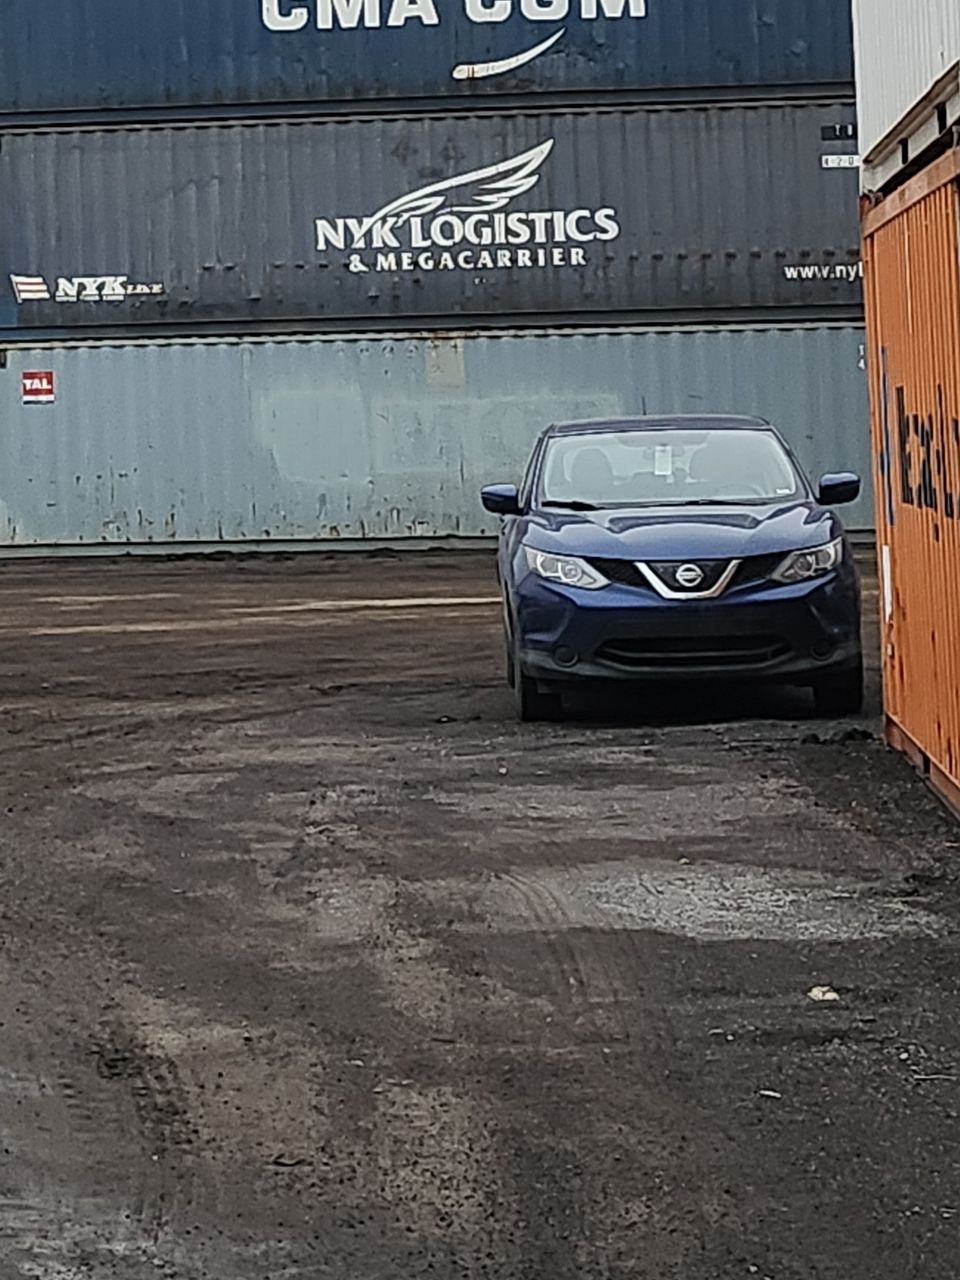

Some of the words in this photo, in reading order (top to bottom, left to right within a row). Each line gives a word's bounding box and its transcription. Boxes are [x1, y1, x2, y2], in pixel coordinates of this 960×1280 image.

[315, 217, 401, 250] NYK
[410, 208, 620, 248] LOGISTICS
[348, 252, 369, 272] &
[375, 247, 587, 271] MEGACARRIER
[56, 276, 127, 296] NYK
[22, 378, 52, 390] TAL
